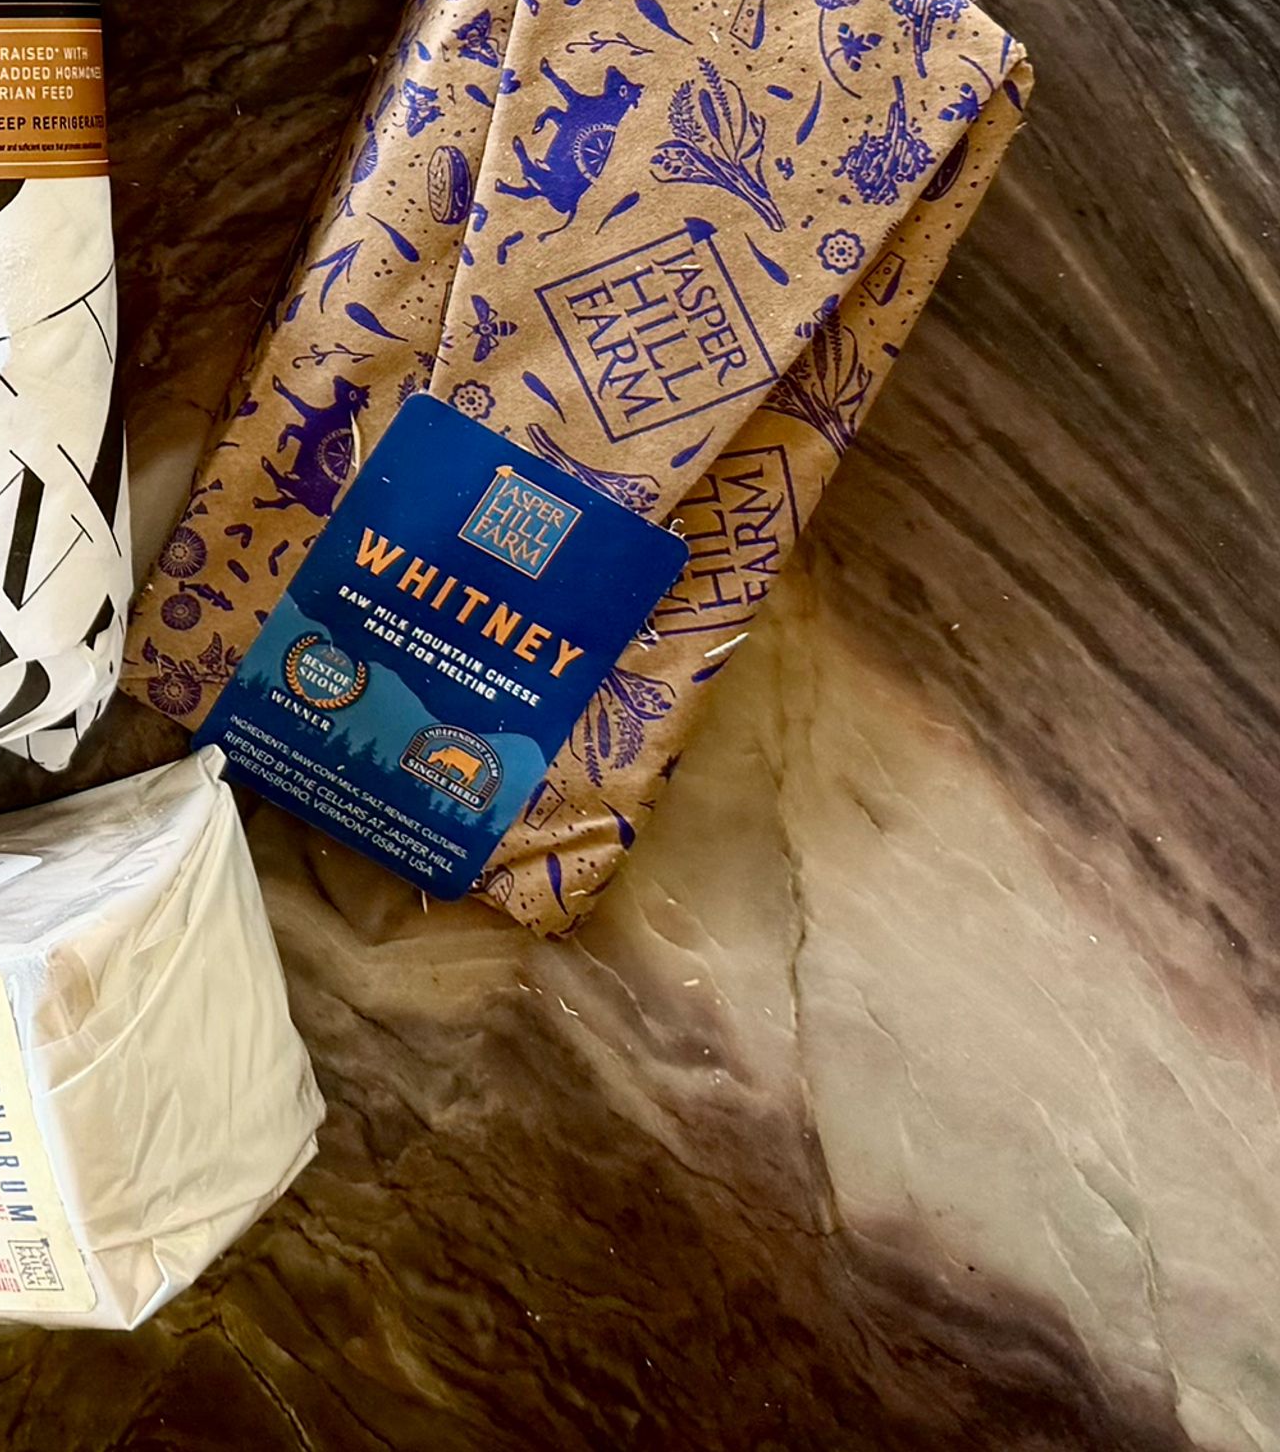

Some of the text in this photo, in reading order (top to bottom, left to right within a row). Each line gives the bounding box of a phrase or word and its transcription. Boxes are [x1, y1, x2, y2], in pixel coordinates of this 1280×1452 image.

[0, 67, 50, 79] ADDED
[42, 86, 73, 98] FEED
[563, 278, 664, 424] FARM
[609, 264, 704, 404] HILL
[650, 246, 748, 388] JASPER
[484, 495, 549, 549] HILL
[496, 477, 565, 529] JASPER
[472, 514, 542, 567] FARM
[355, 526, 585, 678] WHITNEY
[338, 585, 541, 707] RAW MILK MOUNTAIN CHEESE
[363, 617, 497, 700] MADE FOR MELTING
[271, 689, 331, 732] WINNER
